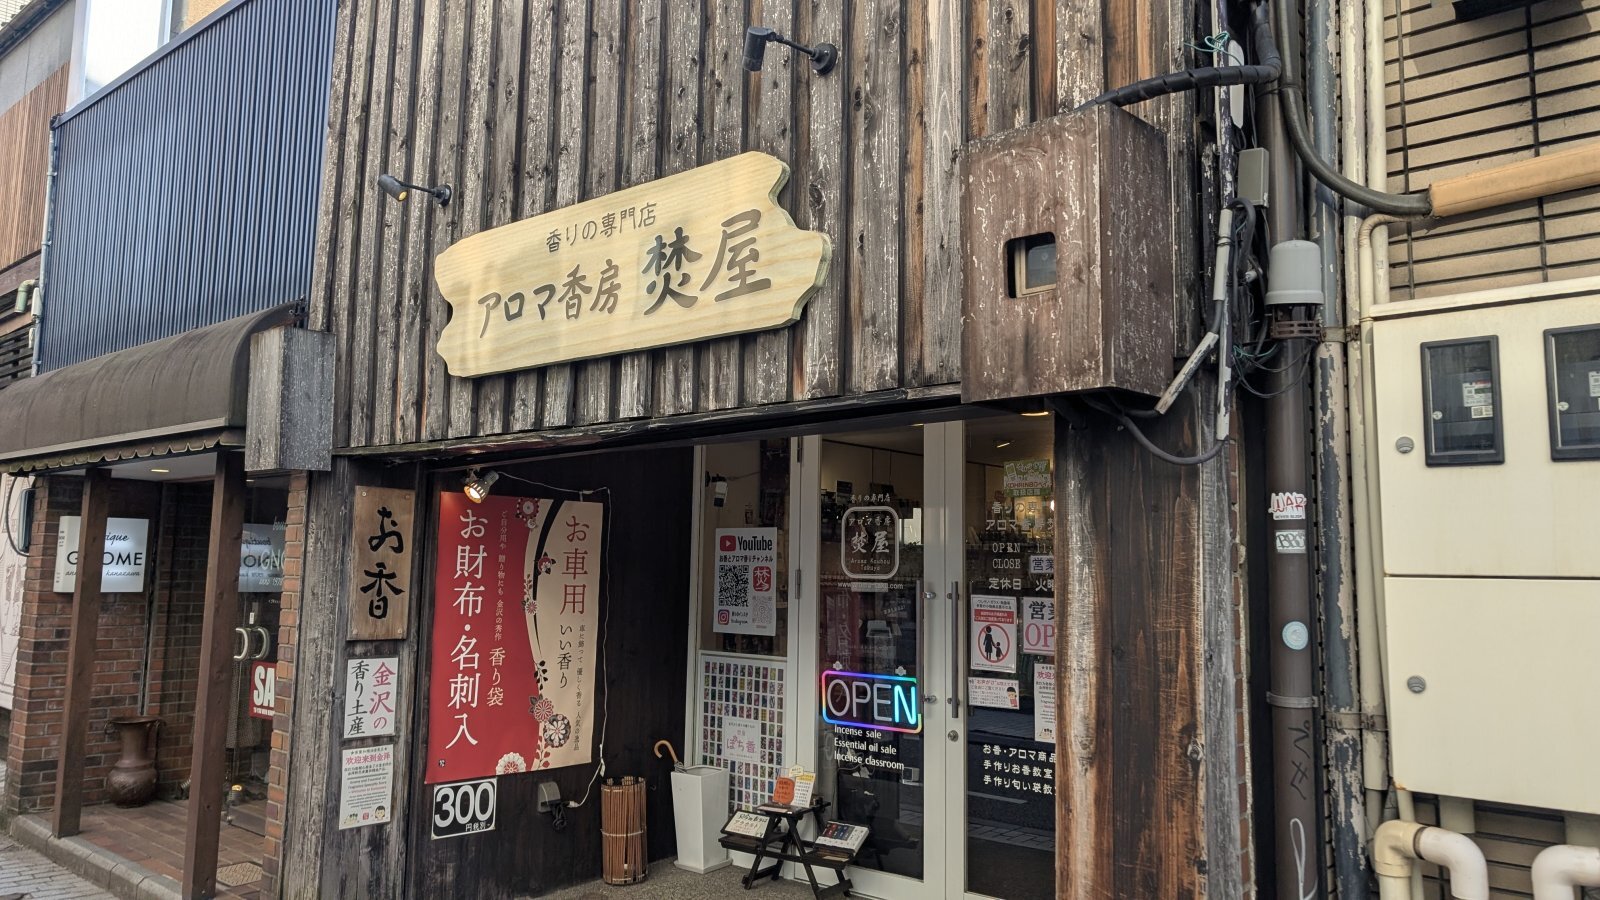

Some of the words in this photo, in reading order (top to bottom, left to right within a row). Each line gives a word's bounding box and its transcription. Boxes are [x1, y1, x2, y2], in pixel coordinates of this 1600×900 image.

[546, 202, 657, 252] 香りの専門店
[478, 259, 621, 338] アロマ香房
[642, 209, 771, 316] 焚屋
[105, 532, 129, 546] ique
[738, 536, 773, 551] YouTube
[851, 531, 890, 554] 焚屋
[992, 542, 1020, 553] OPEN
[67, 551, 143, 566] GOME
[360, 506, 405, 619] お香
[560, 515, 590, 616] お車用
[992, 559, 1021, 569] CLOSE
[989, 577, 1021, 590] 定休日
[446, 509, 488, 750] お財布・名刺入
[557, 624, 572, 688] いい香り
[486, 647, 506, 707] 香り袋
[347, 660, 370, 736] 香り土産
[369, 662, 396, 729] 金沢の
[827, 679, 917, 725] OPEN
[834, 724, 862, 736] Incense
[865, 730, 882, 739] sale
[834, 738, 866, 750] Essential
[869, 743, 878, 752] oil
[881, 745, 896, 755] sale
[834, 751, 862, 763] Incense
[865, 756, 904, 770] classroom
[984, 760, 1053, 779] 手作りお香教室
[984, 775, 1056, 795] 手作り匂い袋教
[435, 782, 494, 828] 300
